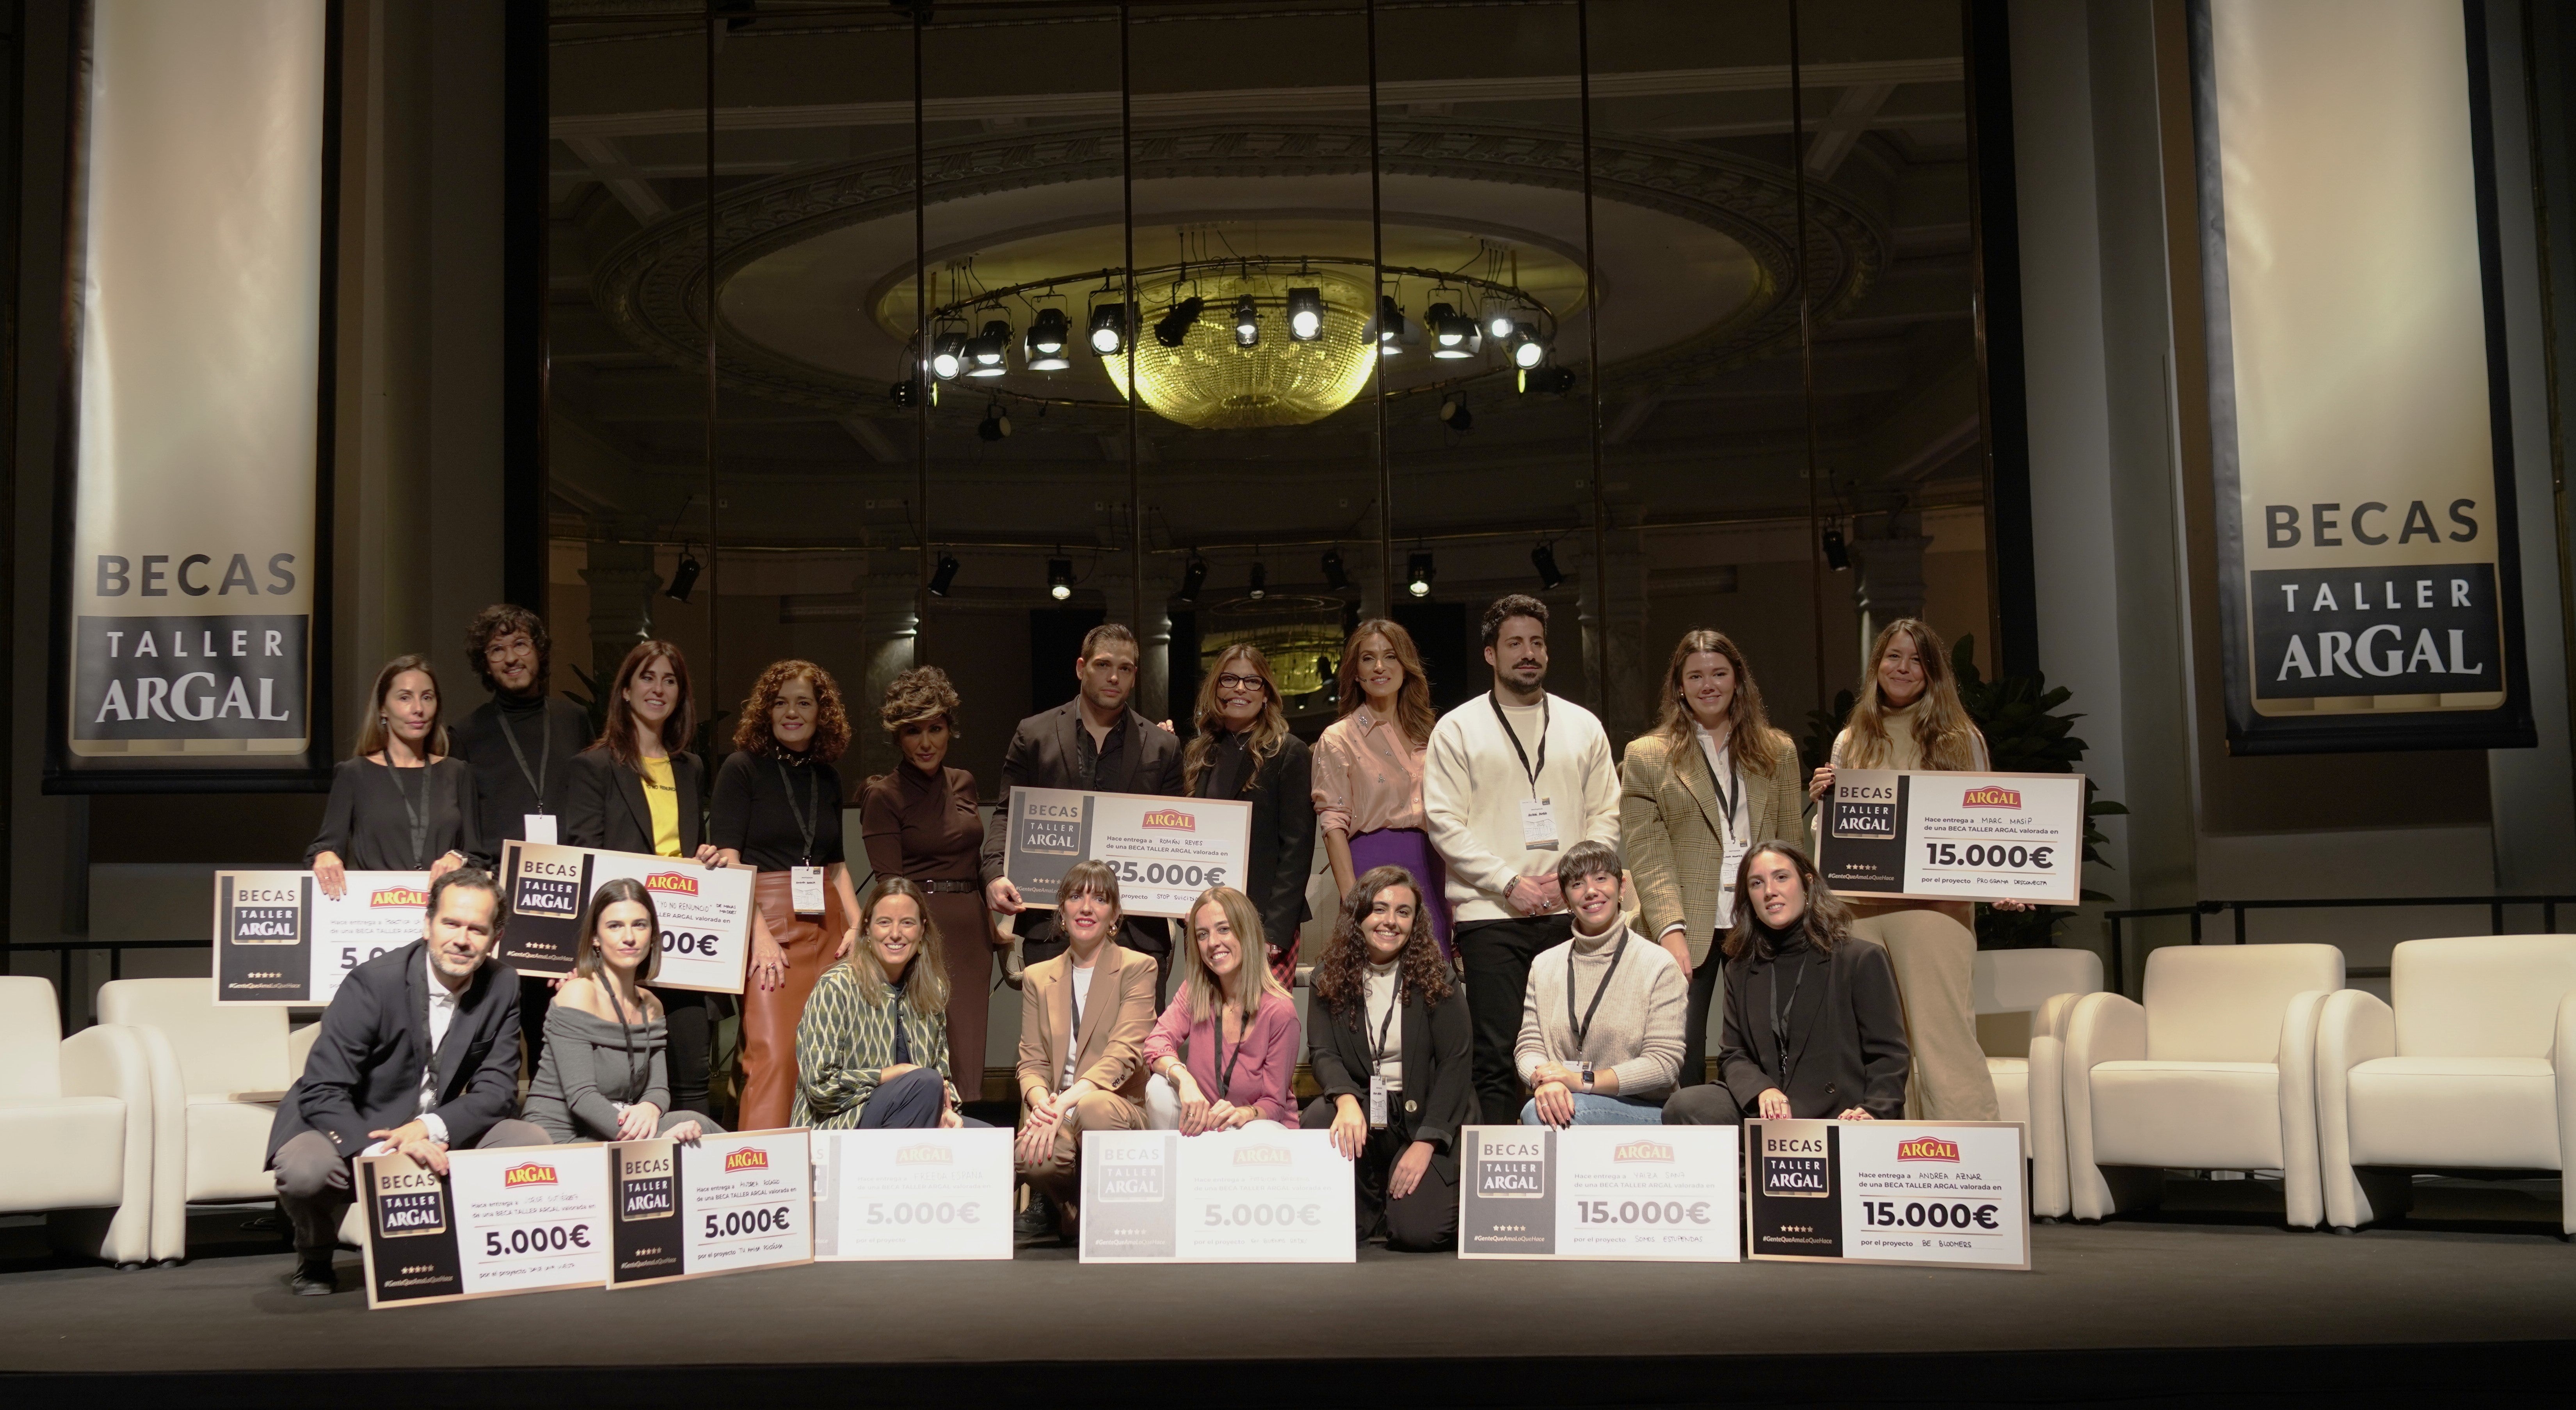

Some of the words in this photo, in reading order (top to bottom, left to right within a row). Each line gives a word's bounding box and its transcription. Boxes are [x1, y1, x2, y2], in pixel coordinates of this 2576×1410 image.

[2265, 499, 2478, 548] BECAS
[96, 553, 296, 596] BECAS
[2281, 579, 2471, 612] TALLER
[107, 630, 283, 657] TALLER
[2277, 624, 2482, 681] ARGAL
[95, 672, 289, 722] ARGAL
[1840, 787, 1892, 799] BECAS
[1966, 791, 2018, 805] ARGAL
[1029, 804, 1077, 817] BECAS
[1842, 806, 1888, 814] TALLER
[1031, 823, 1073, 831] TALLER
[1146, 814, 1192, 828] ARGAL
[1839, 817, 1890, 831] ARGAL
[1028, 834, 1074, 847] ARGAL
[1927, 843, 2053, 868] 15.000€
[524, 861, 576, 876] BECAS
[1106, 860, 1226, 887] 25.000€
[525, 881, 572, 893] TALLER
[647, 876, 695, 892] ARGAL
[239, 890, 294, 901] BECAS
[373, 891, 426, 904] ARGAL
[521, 894, 572, 910] ARGAL
[238, 922, 294, 936] ARGAL
[661, 931, 719, 956] 00€
[507, 951, 574, 962] #GenteQueAmaLoQueHace
[1484, 1144, 1539, 1155] BECAS
[1618, 1145, 1671, 1159] ARGAL
[1768, 1140, 1822, 1152] BECAS
[1901, 1142, 1956, 1158] ARGAL
[727, 1152, 766, 1168] ARGAL
[900, 1147, 951, 1161] ARGAL
[1105, 1149, 1159, 1160] BECAS
[1236, 1149, 1289, 1162] ARGAL
[626, 1159, 669, 1175] BECAS
[1486, 1164, 1536, 1172] TALLER
[1771, 1161, 1820, 1170] TALLER
[507, 1167, 555, 1184] ARGAL
[952, 1168, 983, 1180] ESPAÑA
[1770, 1172, 1823, 1188] ARGAL
[381, 1173, 436, 1190] BECAS
[628, 1181, 667, 1192] TALLER
[1105, 1180, 1158, 1193] ARGAL
[1484, 1175, 1538, 1189] ARGAL
[386, 1196, 436, 1208] TALLER
[627, 1193, 669, 1212] ARGAL
[387, 1210, 439, 1228] ARGAL
[866, 1202, 981, 1224] 5.000€
[1204, 1204, 1322, 1226] 5.000€
[1578, 1201, 1711, 1224] 15.000€
[1863, 1202, 1999, 1229] 15.000€
[705, 1207, 790, 1238] 5.000€
[487, 1224, 591, 1256] 5.000€
